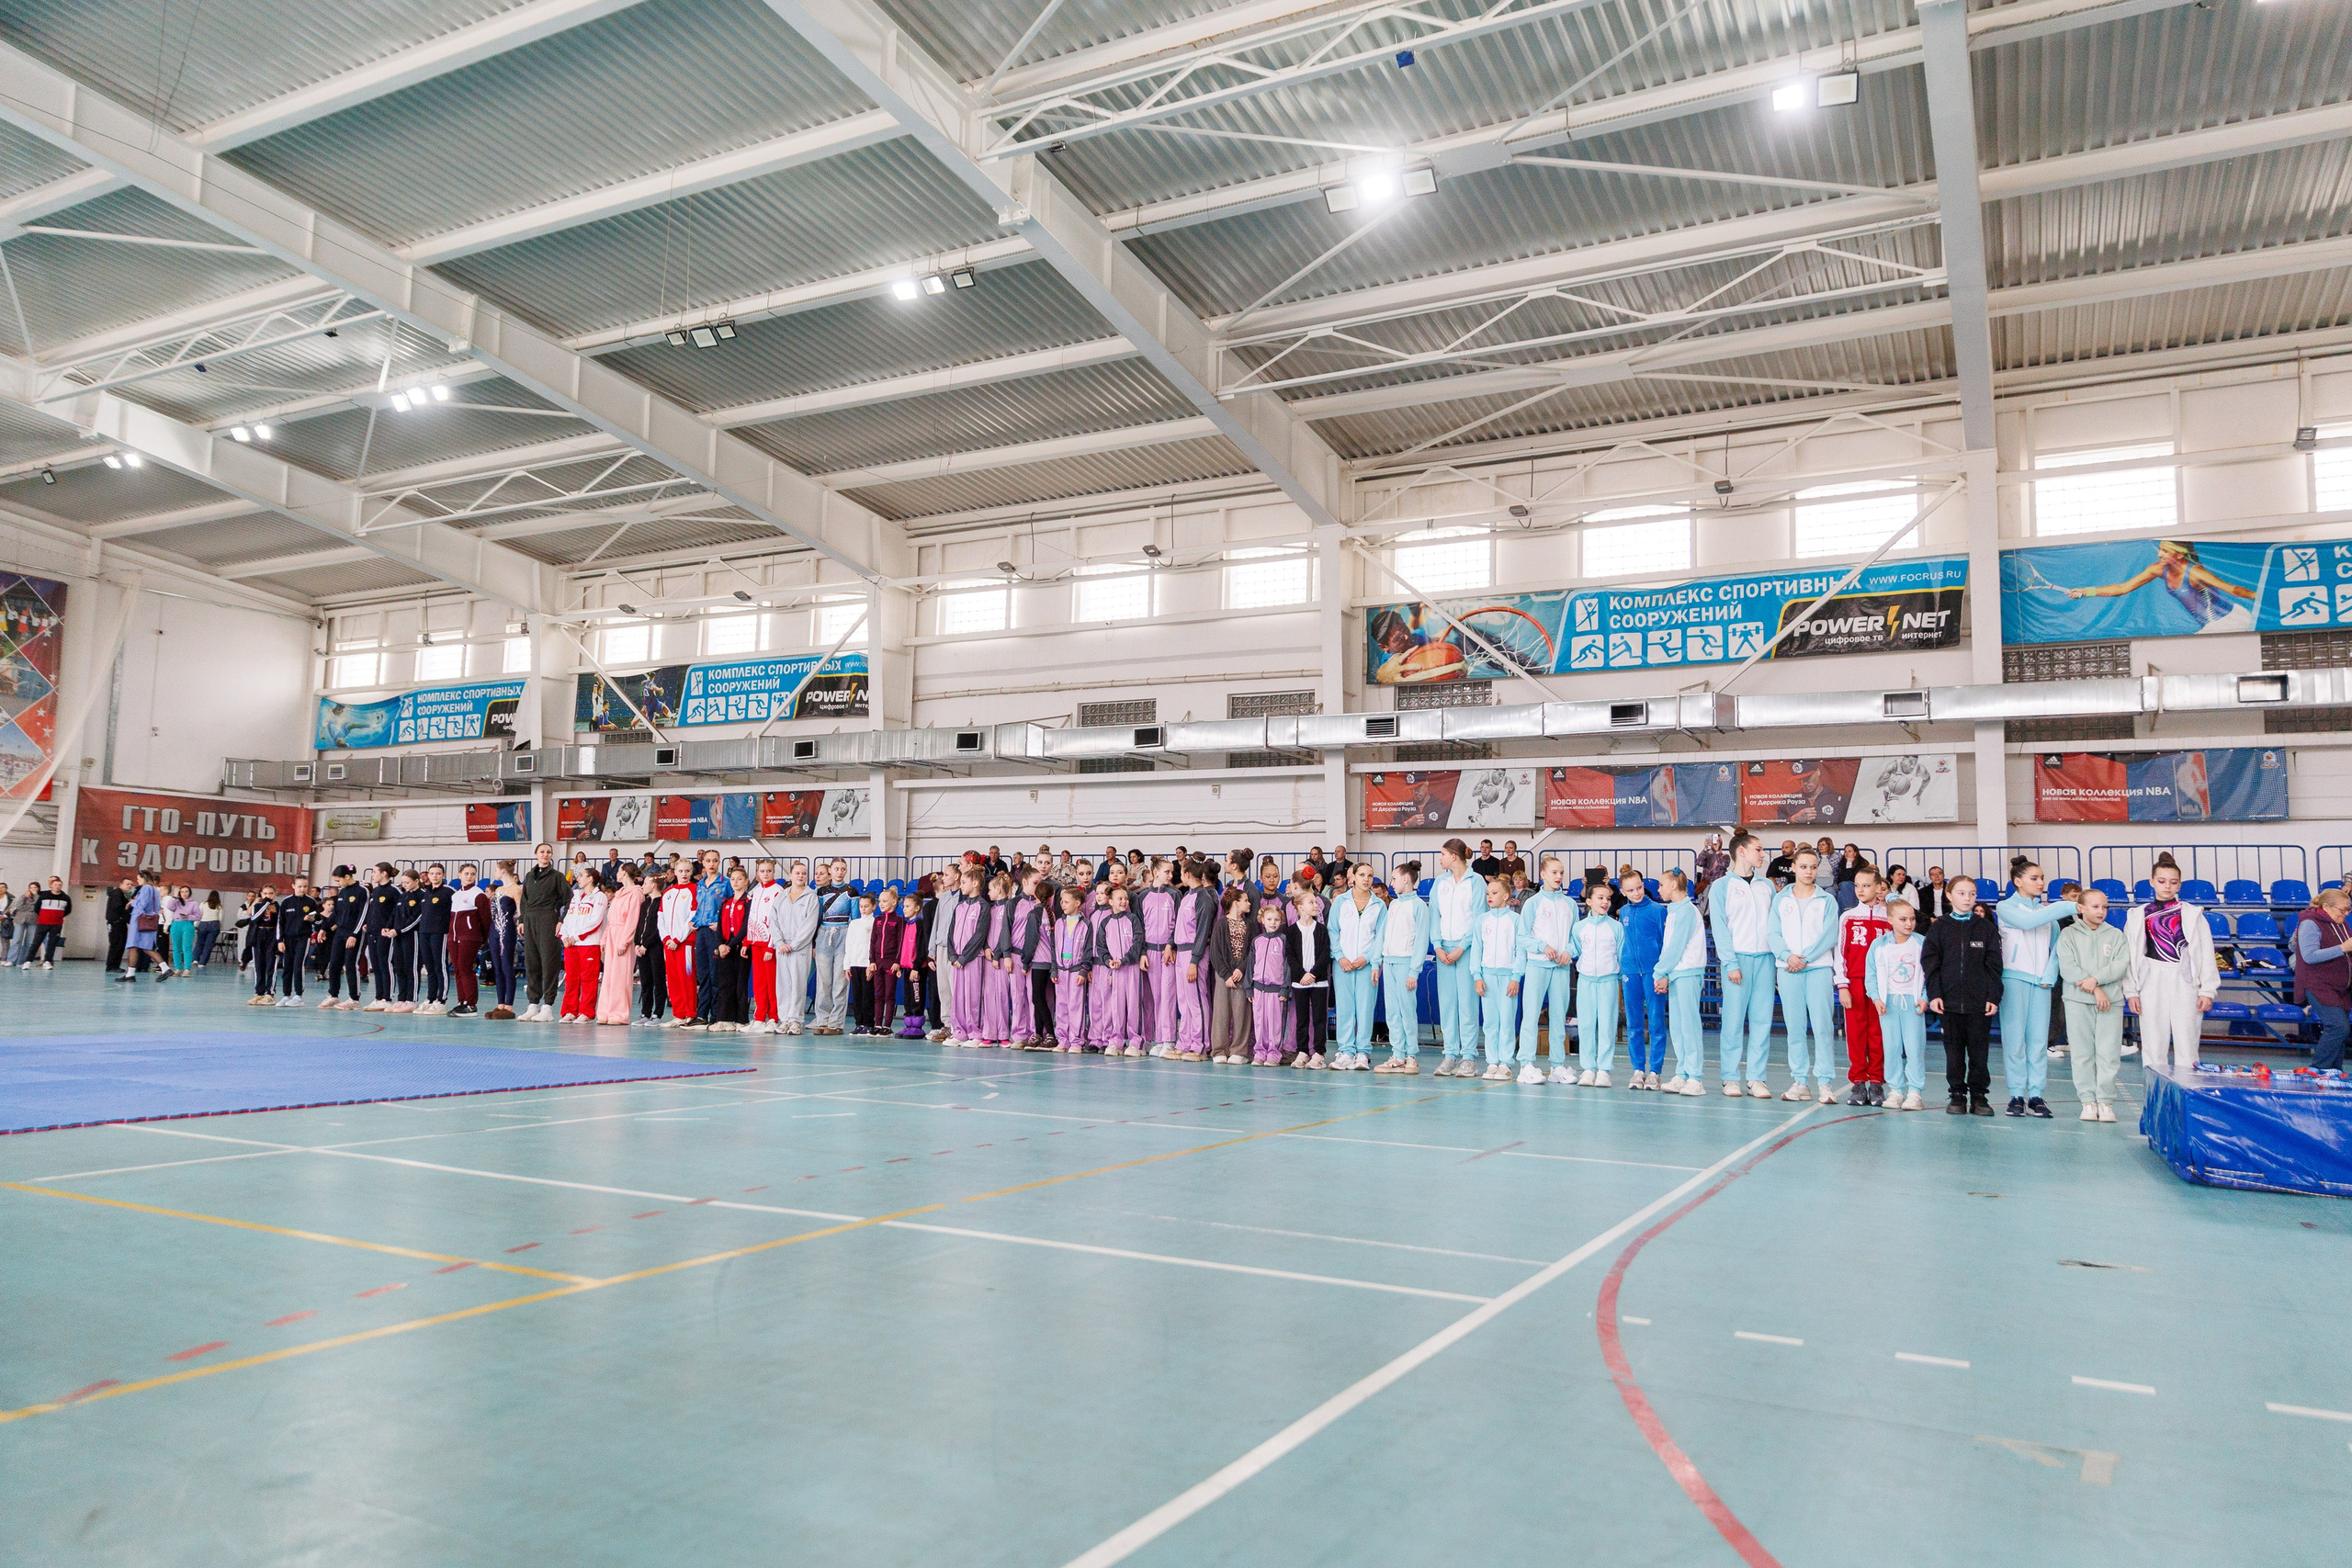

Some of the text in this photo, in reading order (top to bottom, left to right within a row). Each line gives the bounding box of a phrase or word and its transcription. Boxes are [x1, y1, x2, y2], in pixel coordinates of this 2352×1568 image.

[1869, 570, 1962, 585] WWW.FOCRUS.RU
[1609, 587, 1713, 610] КОМПЛЕКС
[1609, 600, 1743, 629] СООРУЖЕНИЙ
[1793, 609, 1951, 637] POWER NET
[1825, 635, 1871, 645] цифровое
[1902, 631, 1942, 640] интернет
[707, 664, 767, 681] КОМПЛЕКС
[707, 676, 780, 694] СООРУЖЕНИЙ
[417, 685, 522, 705] КОМПЛЕКС СПОРТИВНЫХ
[805, 690, 851, 704] POWER
[417, 700, 473, 716] СООРУЖЕНИЙ
[2145, 786, 2171, 795] NBA
[1628, 795, 1648, 805] NBA
[121, 805, 277, 840] ГТО-ПУТЬ
[81, 838, 311, 877] К ЗДОРОВЬЮ!
